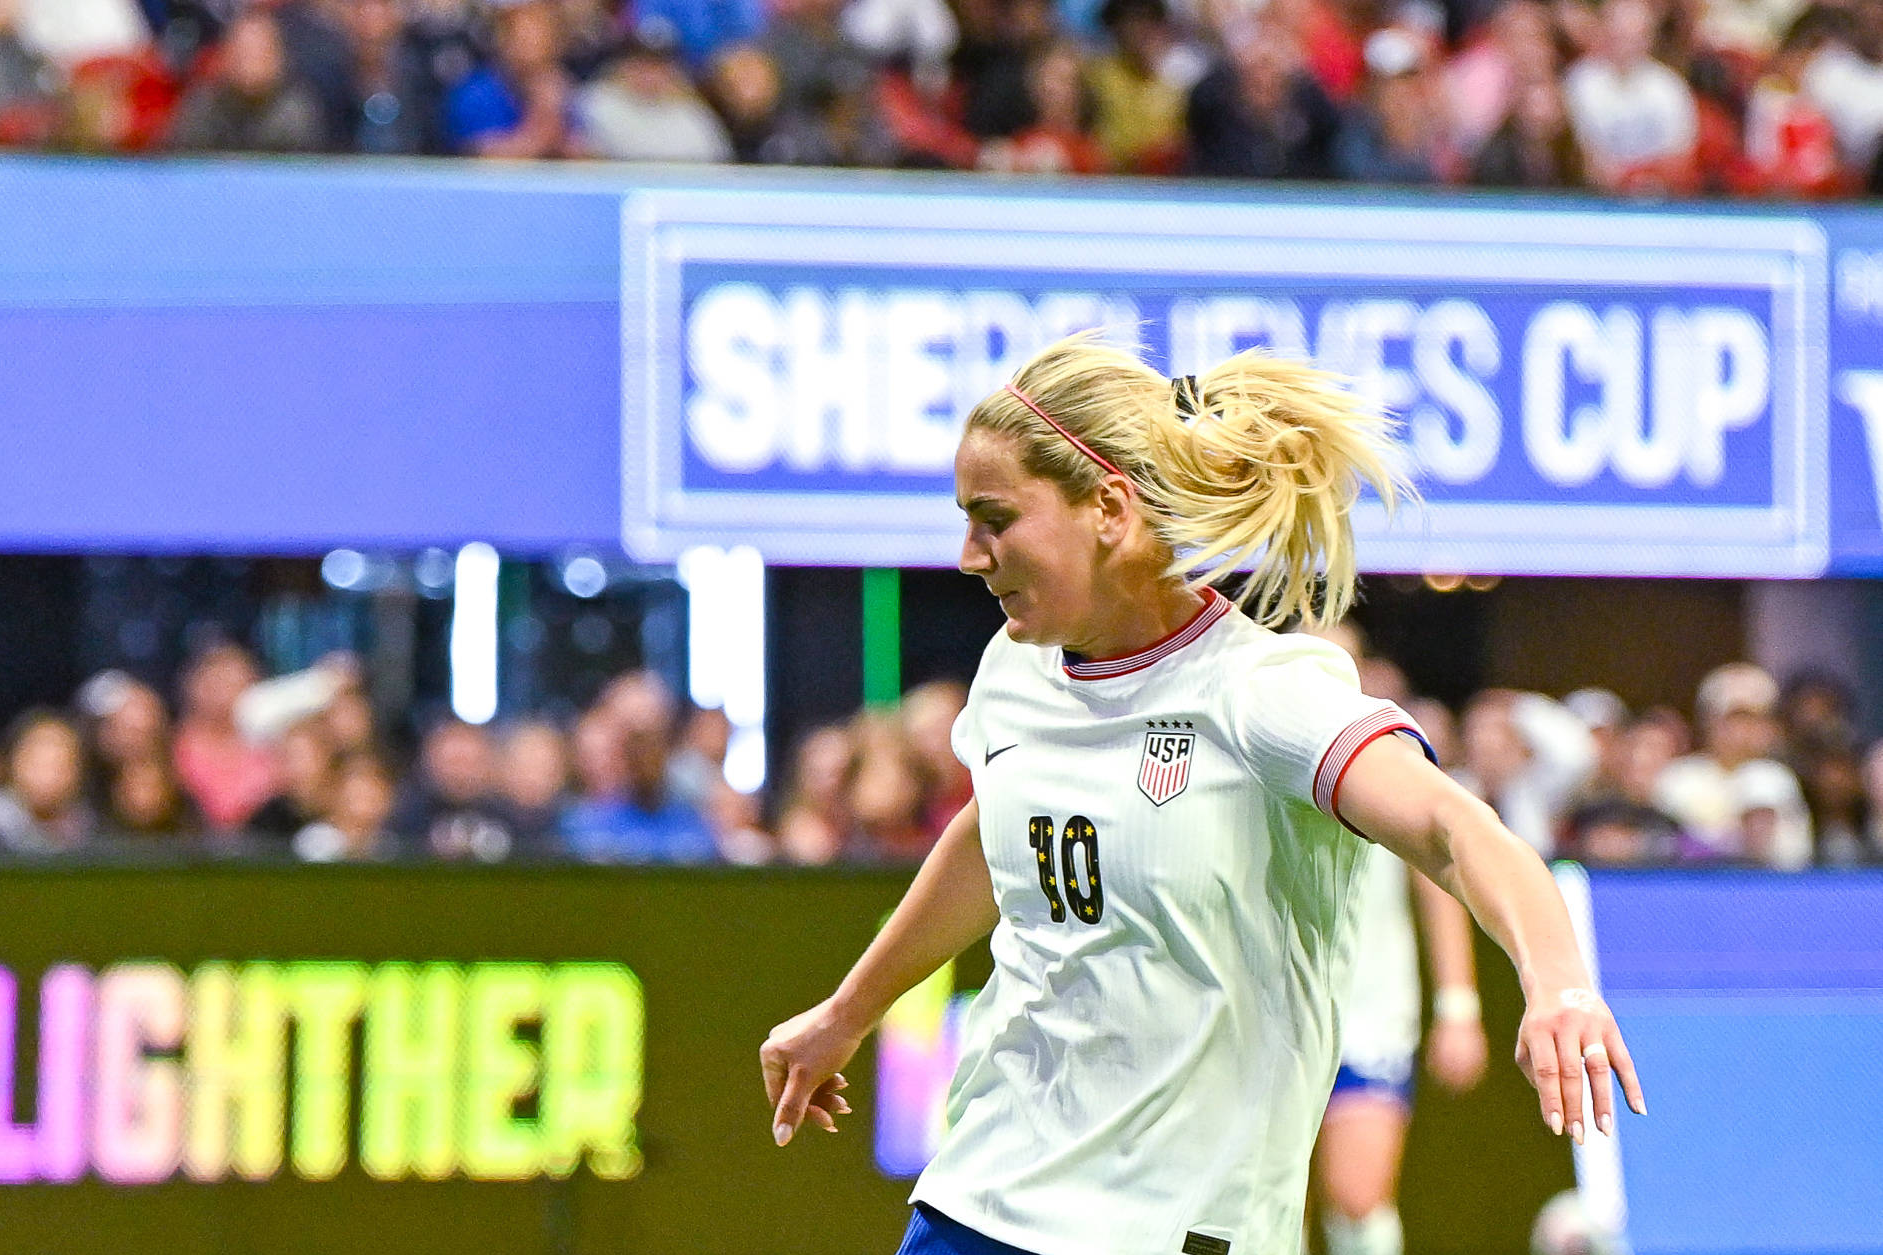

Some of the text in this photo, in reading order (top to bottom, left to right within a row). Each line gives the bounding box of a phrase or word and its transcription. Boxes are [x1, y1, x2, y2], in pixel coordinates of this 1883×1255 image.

[684, 281, 1505, 485] SHEBES
[1524, 299, 1770, 489] CUP
[1149, 737, 1191, 763] USA
[1029, 815, 1104, 925] 10
